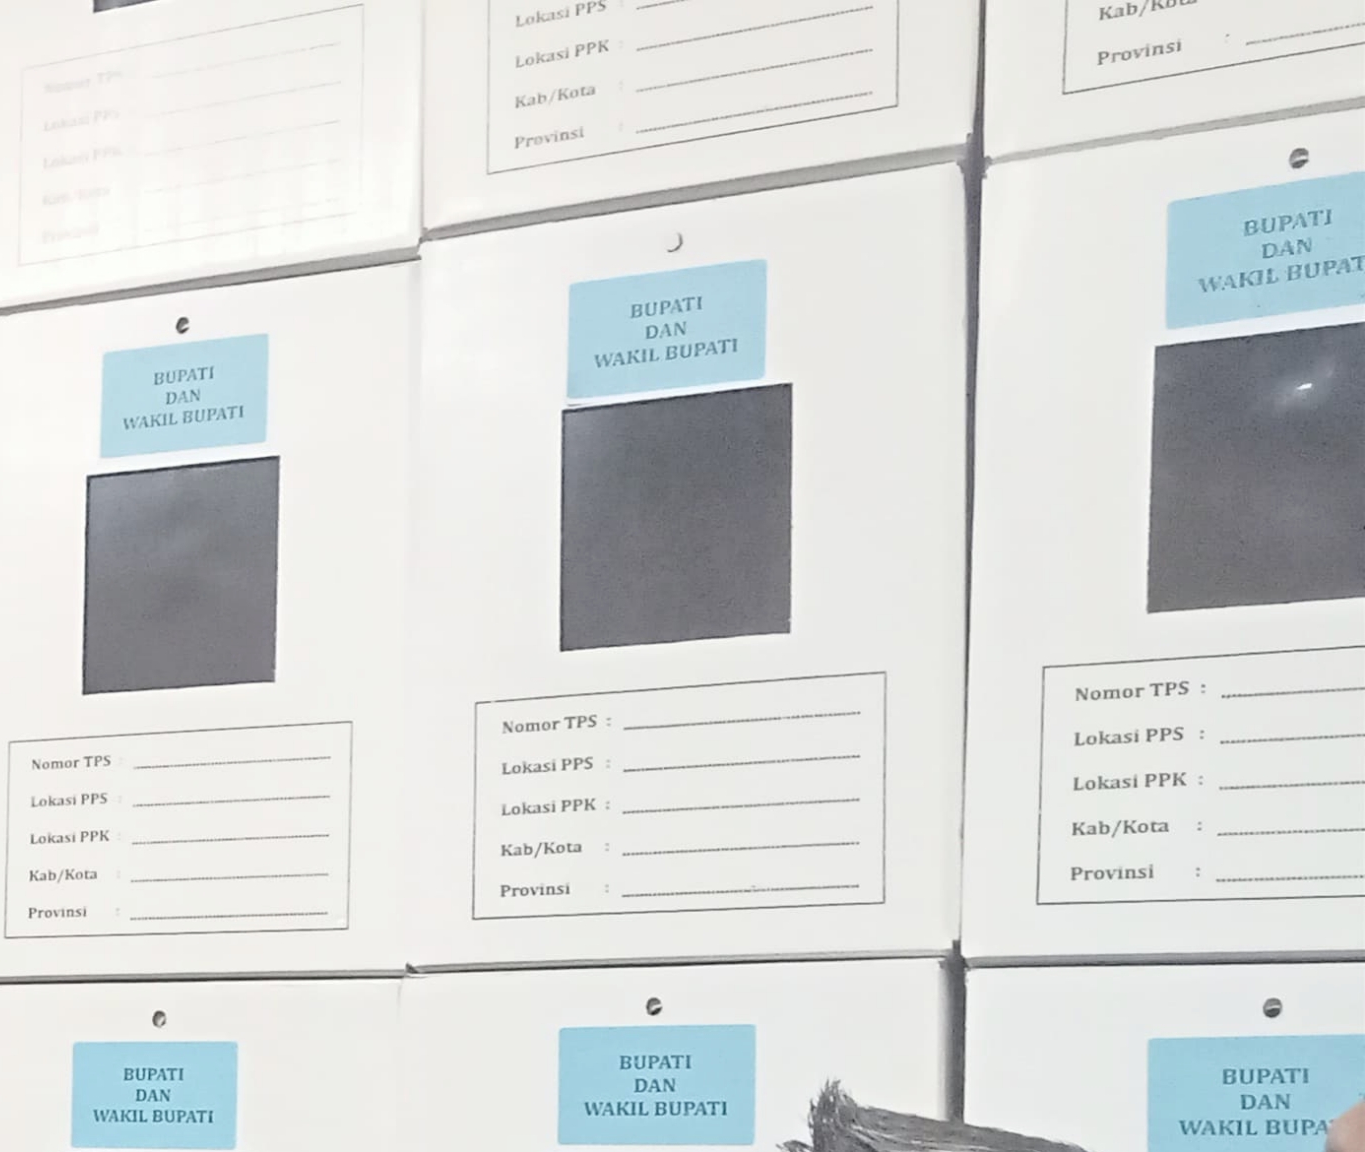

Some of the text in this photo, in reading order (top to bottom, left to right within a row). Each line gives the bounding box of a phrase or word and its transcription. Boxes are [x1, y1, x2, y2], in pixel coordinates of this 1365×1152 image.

[516, 0, 606, 27] Lokasi PPS
[516, 40, 609, 68] Lokasi PPK
[1097, 40, 1181, 65] Provinsi
[515, 85, 595, 109] Kab/Kota
[515, 126, 584, 149] Provinsi
[1244, 209, 1331, 236] BUPATI
[1262, 238, 1312, 259] DAN
[1198, 255, 1365, 292] WAKIL BUPAT
[631, 296, 702, 318] BUPATI
[646, 321, 686, 339] DAN
[595, 338, 737, 368] WAKIL BUPATI
[154, 366, 214, 385] BUPATI
[166, 389, 200, 405] DAN
[123, 405, 243, 430] WAKIL BUPATI
[1076, 681, 1189, 701] Nomor TPS
[503, 715, 597, 733] Nomor TPS
[1075, 727, 1184, 746] Lokasi PPS
[32, 755, 111, 769] Nomor TPS
[502, 757, 593, 775] Lokasi PPS
[1074, 772, 1186, 791] Lokasi PPK
[31, 793, 107, 807] Lokasi PPS
[502, 798, 595, 816] Lokasi PPK
[30, 830, 109, 844] Lokasi PPK
[1072, 820, 1169, 838] Kab/Kota
[501, 842, 582, 858] Kab/Kota
[30, 869, 97, 883] Kab/Kota
[1071, 864, 1153, 881] Provinsi
[501, 885, 570, 897] Provinsi
[29, 907, 86, 919] Provinsi
[620, 1055, 691, 1069] BUPATI
[124, 1068, 183, 1081] BUPATI
[1223, 1068, 1308, 1084] BUPATI
[634, 1078, 675, 1092] DAN
[136, 1089, 170, 1102] DAN
[1241, 1094, 1290, 1110] DAN
[93, 1109, 213, 1123] WAKIL BUPATI
[584, 1101, 727, 1116] WAKIL BUPATI
[1179, 1119, 1333, 1135] WAKIL BUPA
